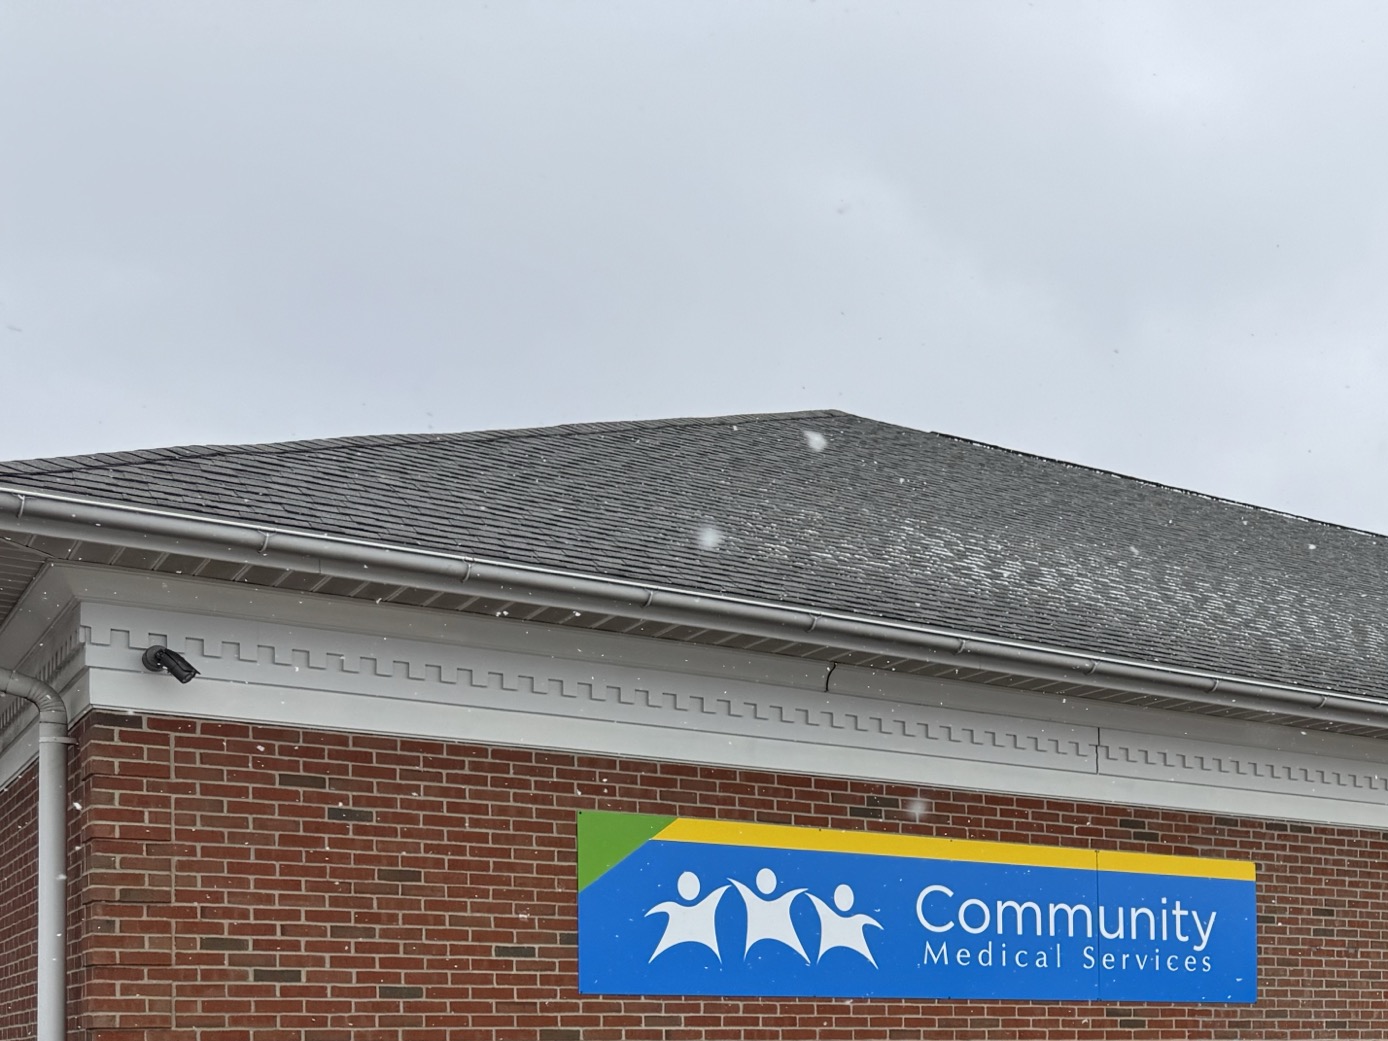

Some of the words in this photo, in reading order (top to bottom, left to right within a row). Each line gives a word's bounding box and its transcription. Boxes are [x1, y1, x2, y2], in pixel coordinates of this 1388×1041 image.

[915, 884, 1217, 952] Community
[923, 940, 1062, 969] Medical
[1082, 944, 1212, 973] Services
